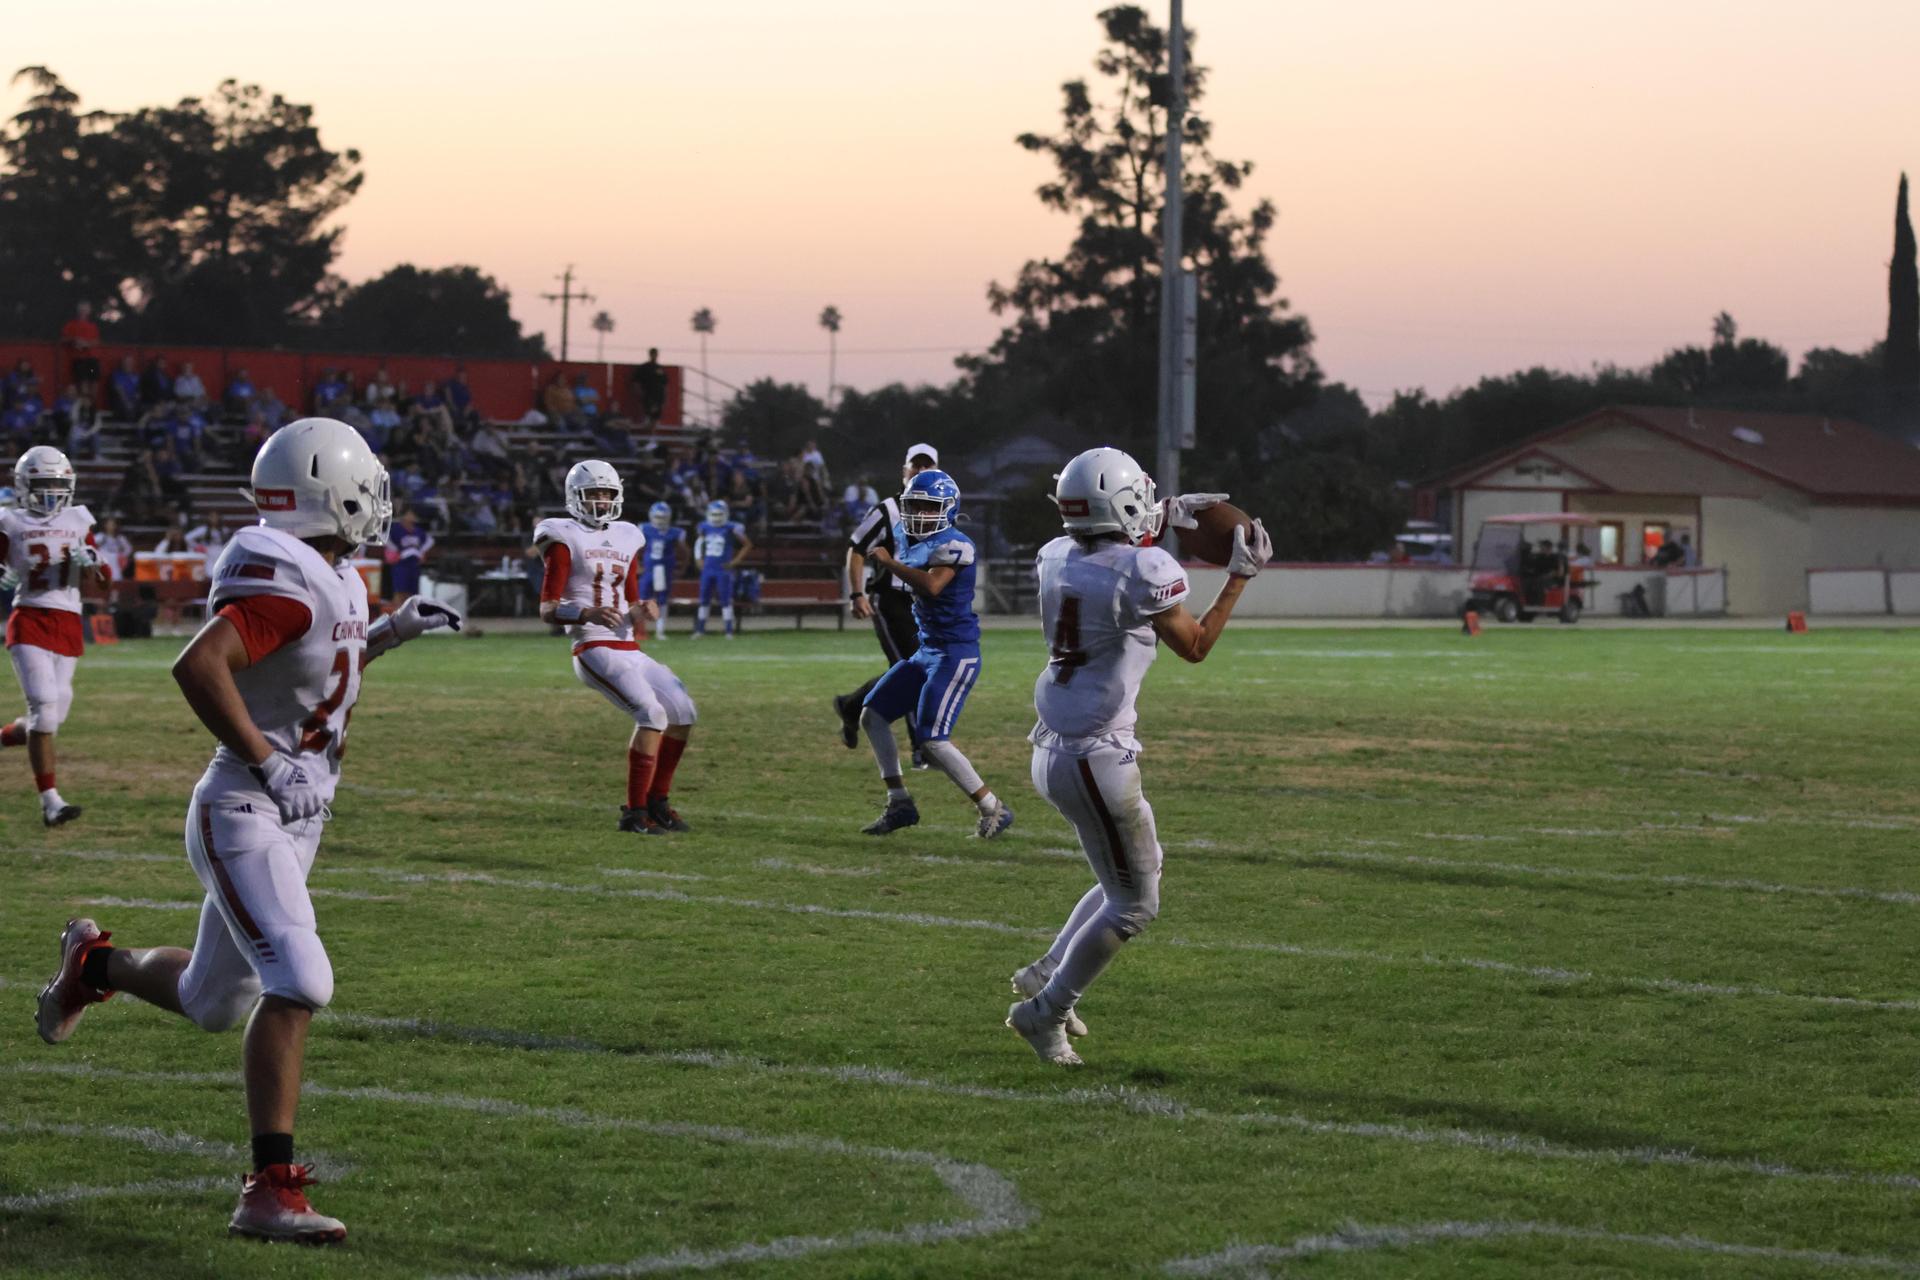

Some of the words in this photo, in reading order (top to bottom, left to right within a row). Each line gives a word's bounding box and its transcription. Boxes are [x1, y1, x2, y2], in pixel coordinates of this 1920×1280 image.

[29, 543, 71, 592] 21
[949, 549, 963, 566] 7
[593, 562, 625, 608] 17
[331, 619, 368, 642] CHOWCHILL
[1050, 592, 1088, 685] 4
